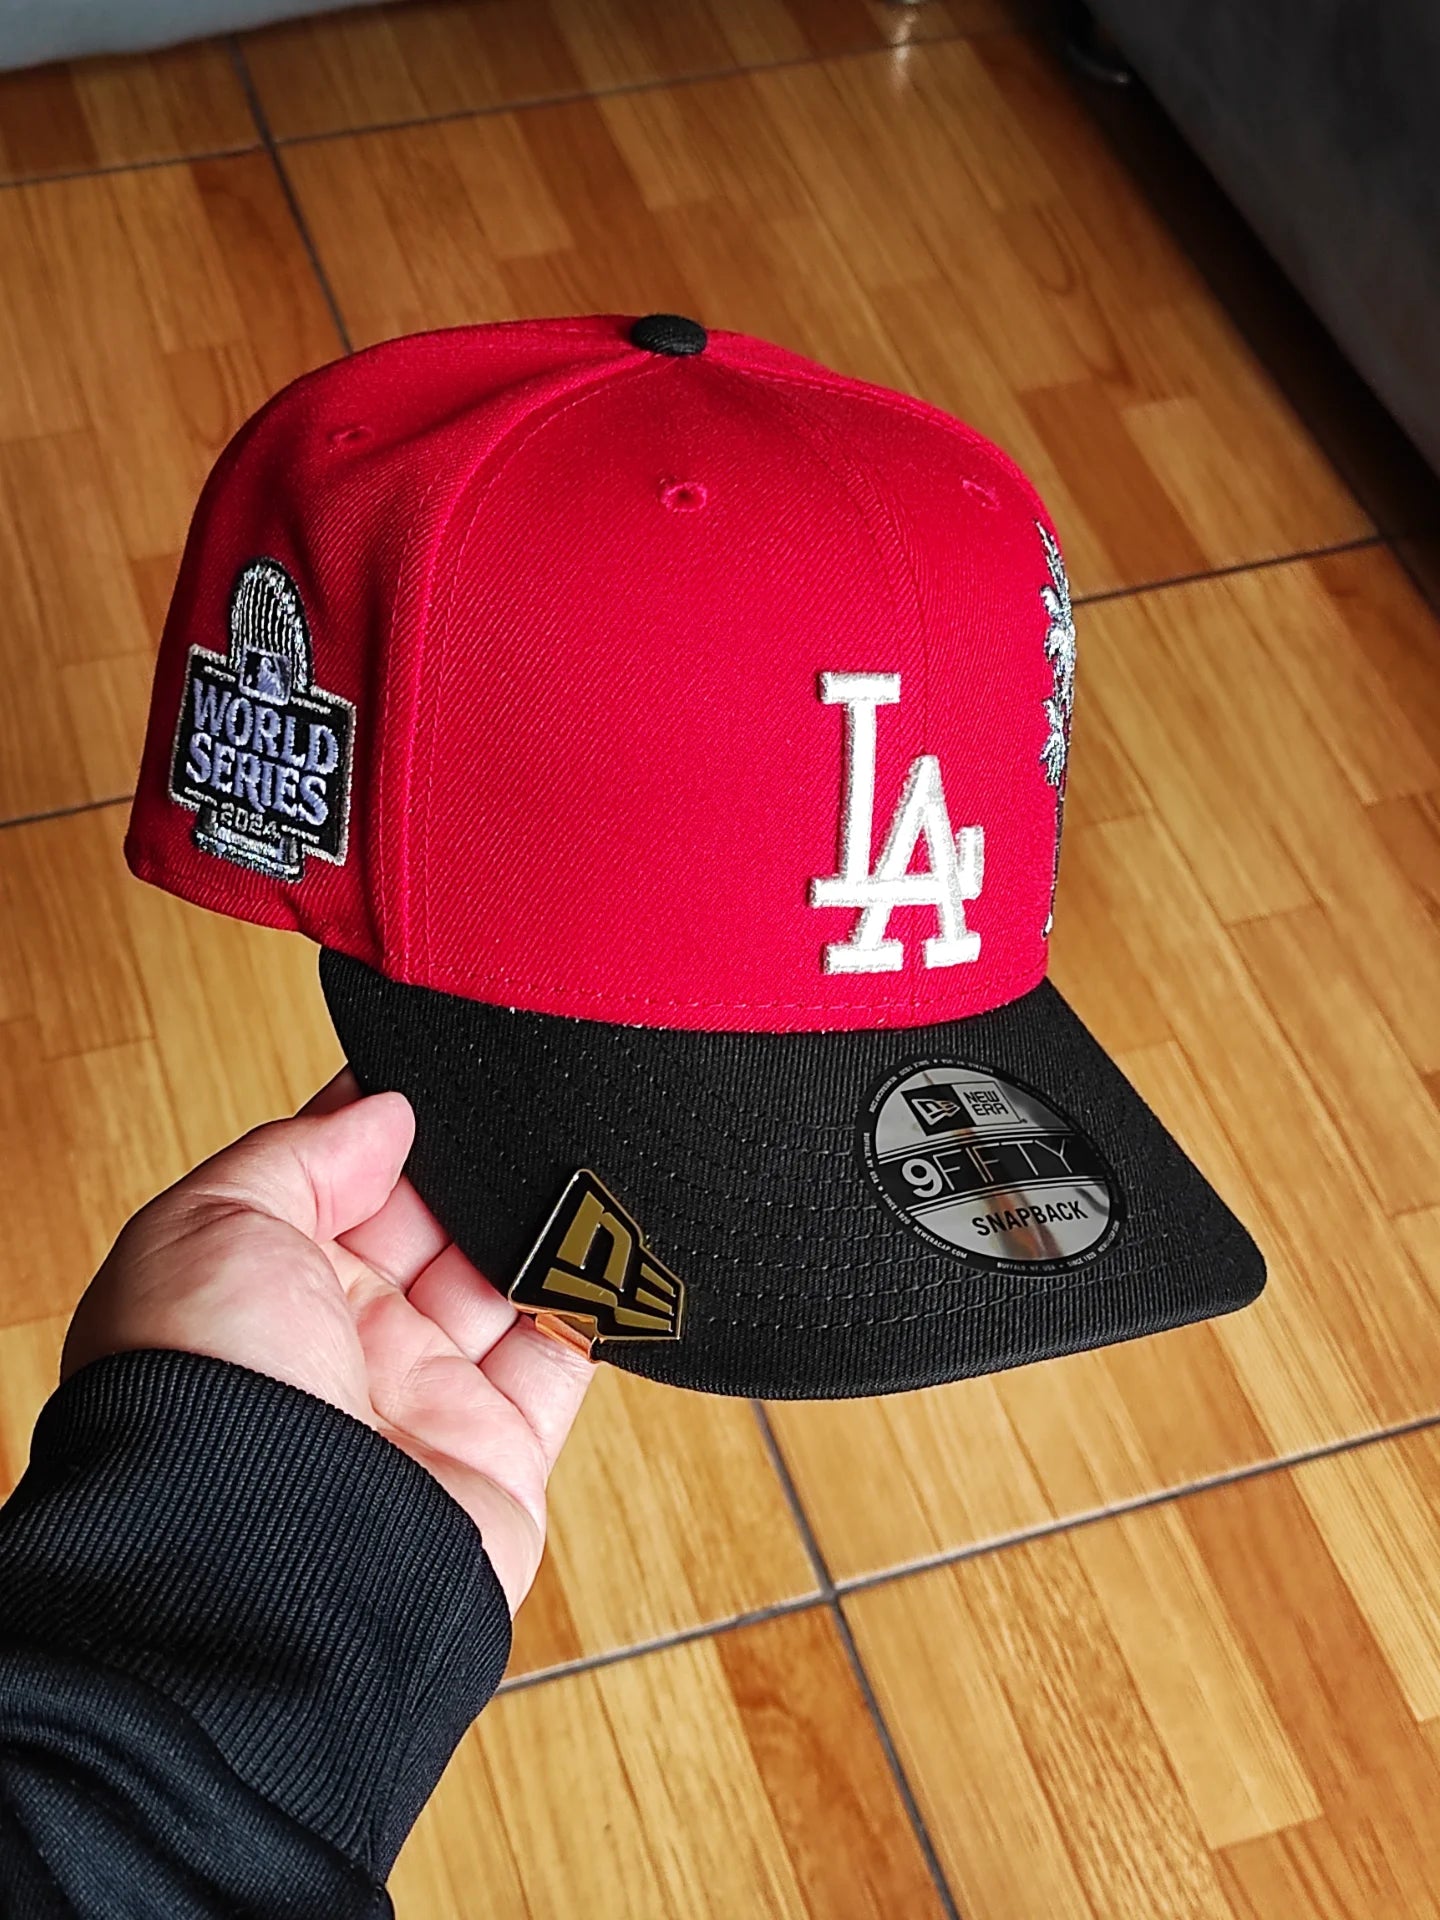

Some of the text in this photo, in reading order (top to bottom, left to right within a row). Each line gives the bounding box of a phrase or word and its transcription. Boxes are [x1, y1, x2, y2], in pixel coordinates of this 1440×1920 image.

[193, 678, 339, 775] WORLD
[185, 732, 330, 826] SERIES
[808, 671, 985, 975] LA
[963, 1090, 1001, 1104] NEW
[971, 1102, 1010, 1116] ERA
[901, 1138, 1073, 1198] 9FIFTY
[971, 1200, 1089, 1237] SNAPBACK
